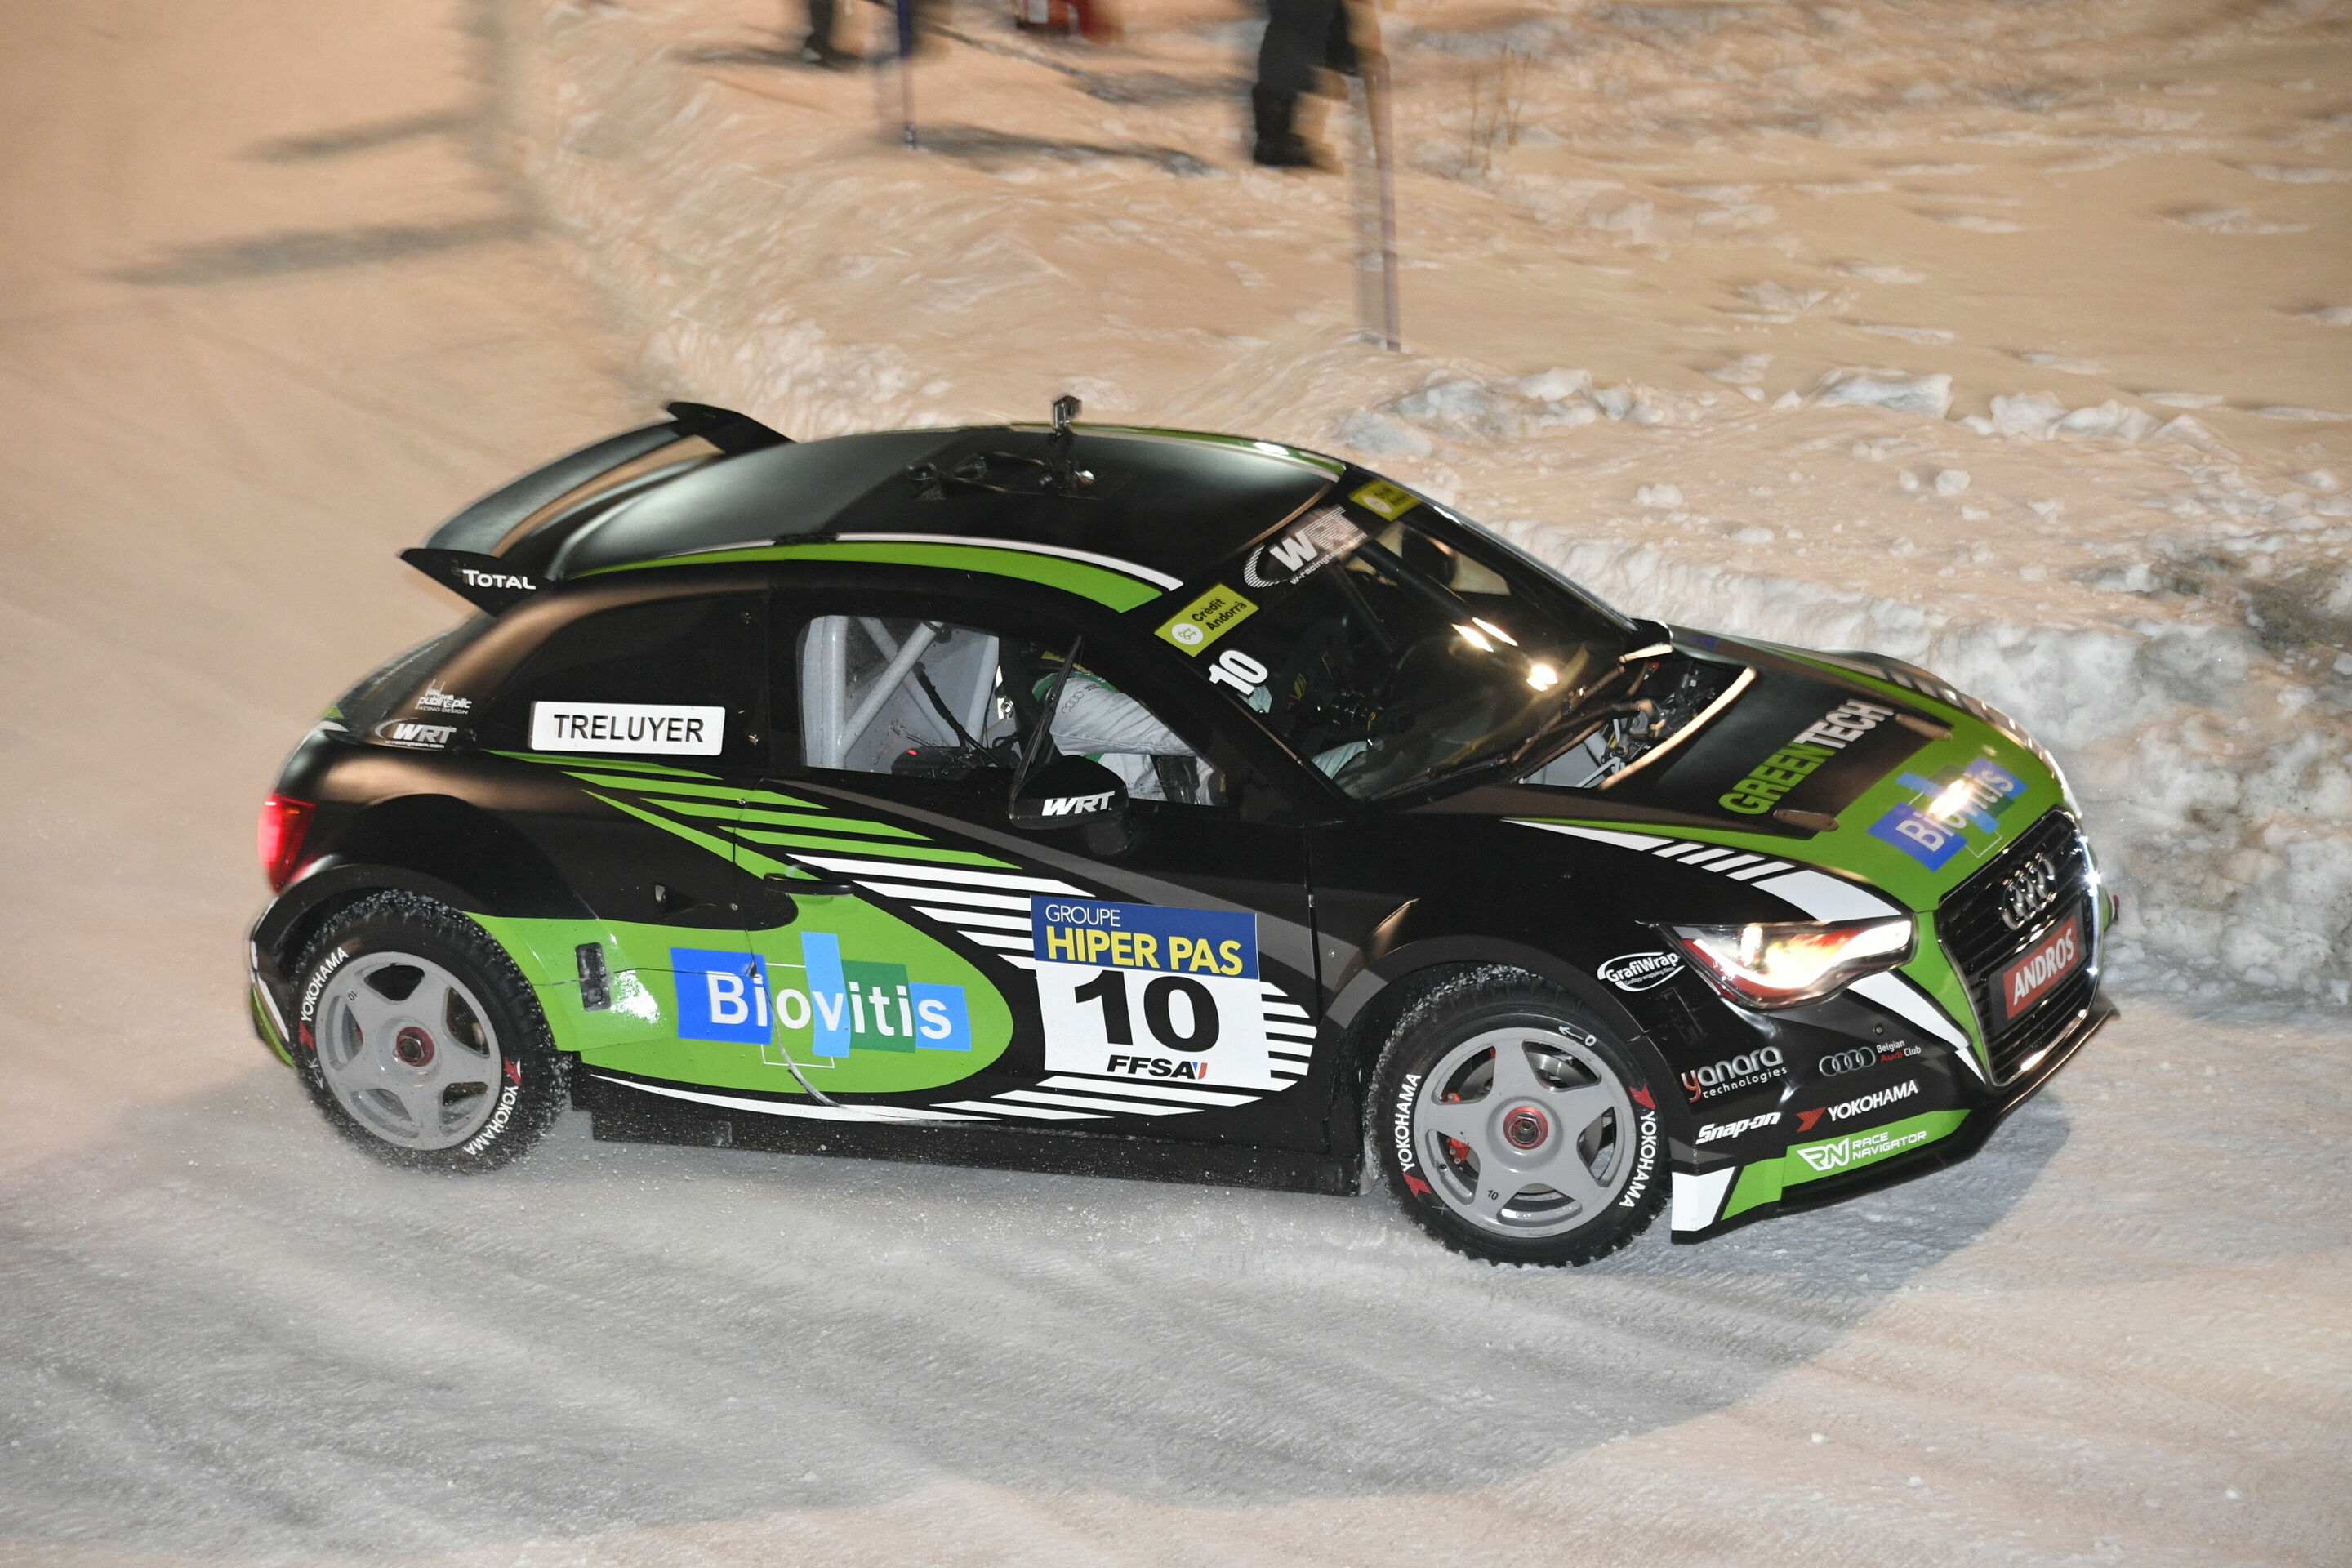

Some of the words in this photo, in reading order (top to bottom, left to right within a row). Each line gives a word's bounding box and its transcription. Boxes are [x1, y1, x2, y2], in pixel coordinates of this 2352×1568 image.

[1269, 506, 1360, 572] WRT
[462, 569, 537, 590] TOTAL
[1192, 597, 1227, 622] Crèdit
[1205, 601, 1247, 631] Andorrà
[1209, 650, 1268, 695] 10
[393, 724, 457, 744] WRT
[553, 713, 704, 742] TRELUYER
[1042, 791, 1116, 817] WRT
[1045, 904, 1121, 927] GROUPE
[1046, 925, 1160, 969] HIPER
[1169, 936, 1243, 976] PAS
[1606, 952, 1678, 982] GrafiWrap
[2013, 928, 2074, 1006] ANDROS
[301, 947, 350, 1022] YOKOHAMA
[706, 970, 952, 1040] Biovitis
[1074, 969, 1220, 1052] 10
[1876, 1040, 1905, 1054] Belgian
[1881, 1049, 1904, 1063] Audi
[1904, 1045, 1922, 1057] Club
[1107, 1054, 1196, 1080] FFSA
[1702, 1066, 1787, 1099] technologies
[1828, 1080, 1919, 1121] YOKOHAMA
[463, 1085, 519, 1156] YOKOHAMA
[1393, 1073, 1421, 1173] YOKOHAMA
[1695, 1111, 1782, 1144] Snap-on
[1852, 1132, 1889, 1149] RACE
[1852, 1130, 1927, 1160] NAVIGATOR
[1619, 1111, 1656, 1209] YOKOHAMA
[1486, 1189, 1499, 1200] 10
